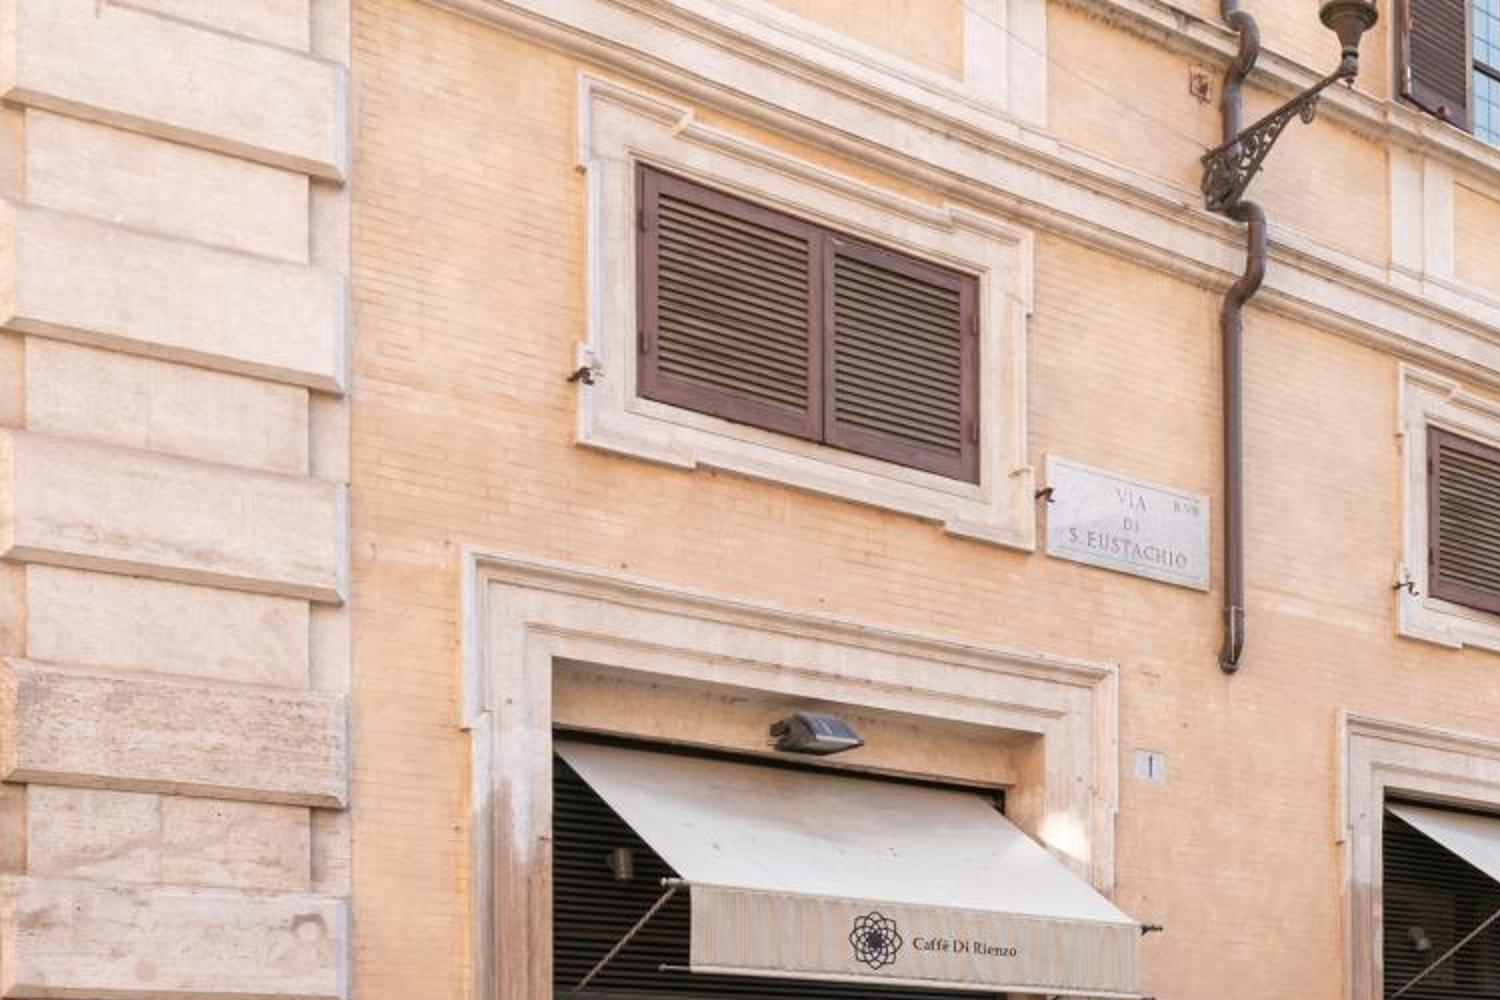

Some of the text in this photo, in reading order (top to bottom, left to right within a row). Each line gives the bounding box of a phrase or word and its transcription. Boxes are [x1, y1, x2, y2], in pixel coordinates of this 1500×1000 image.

[1117, 488, 1148, 512] VIA
[1123, 517, 1138, 532] DI
[1087, 531, 1188, 569] EUSTACHIO
[953, 939, 969, 953] Di
[973, 941, 1017, 957] Rienzo
